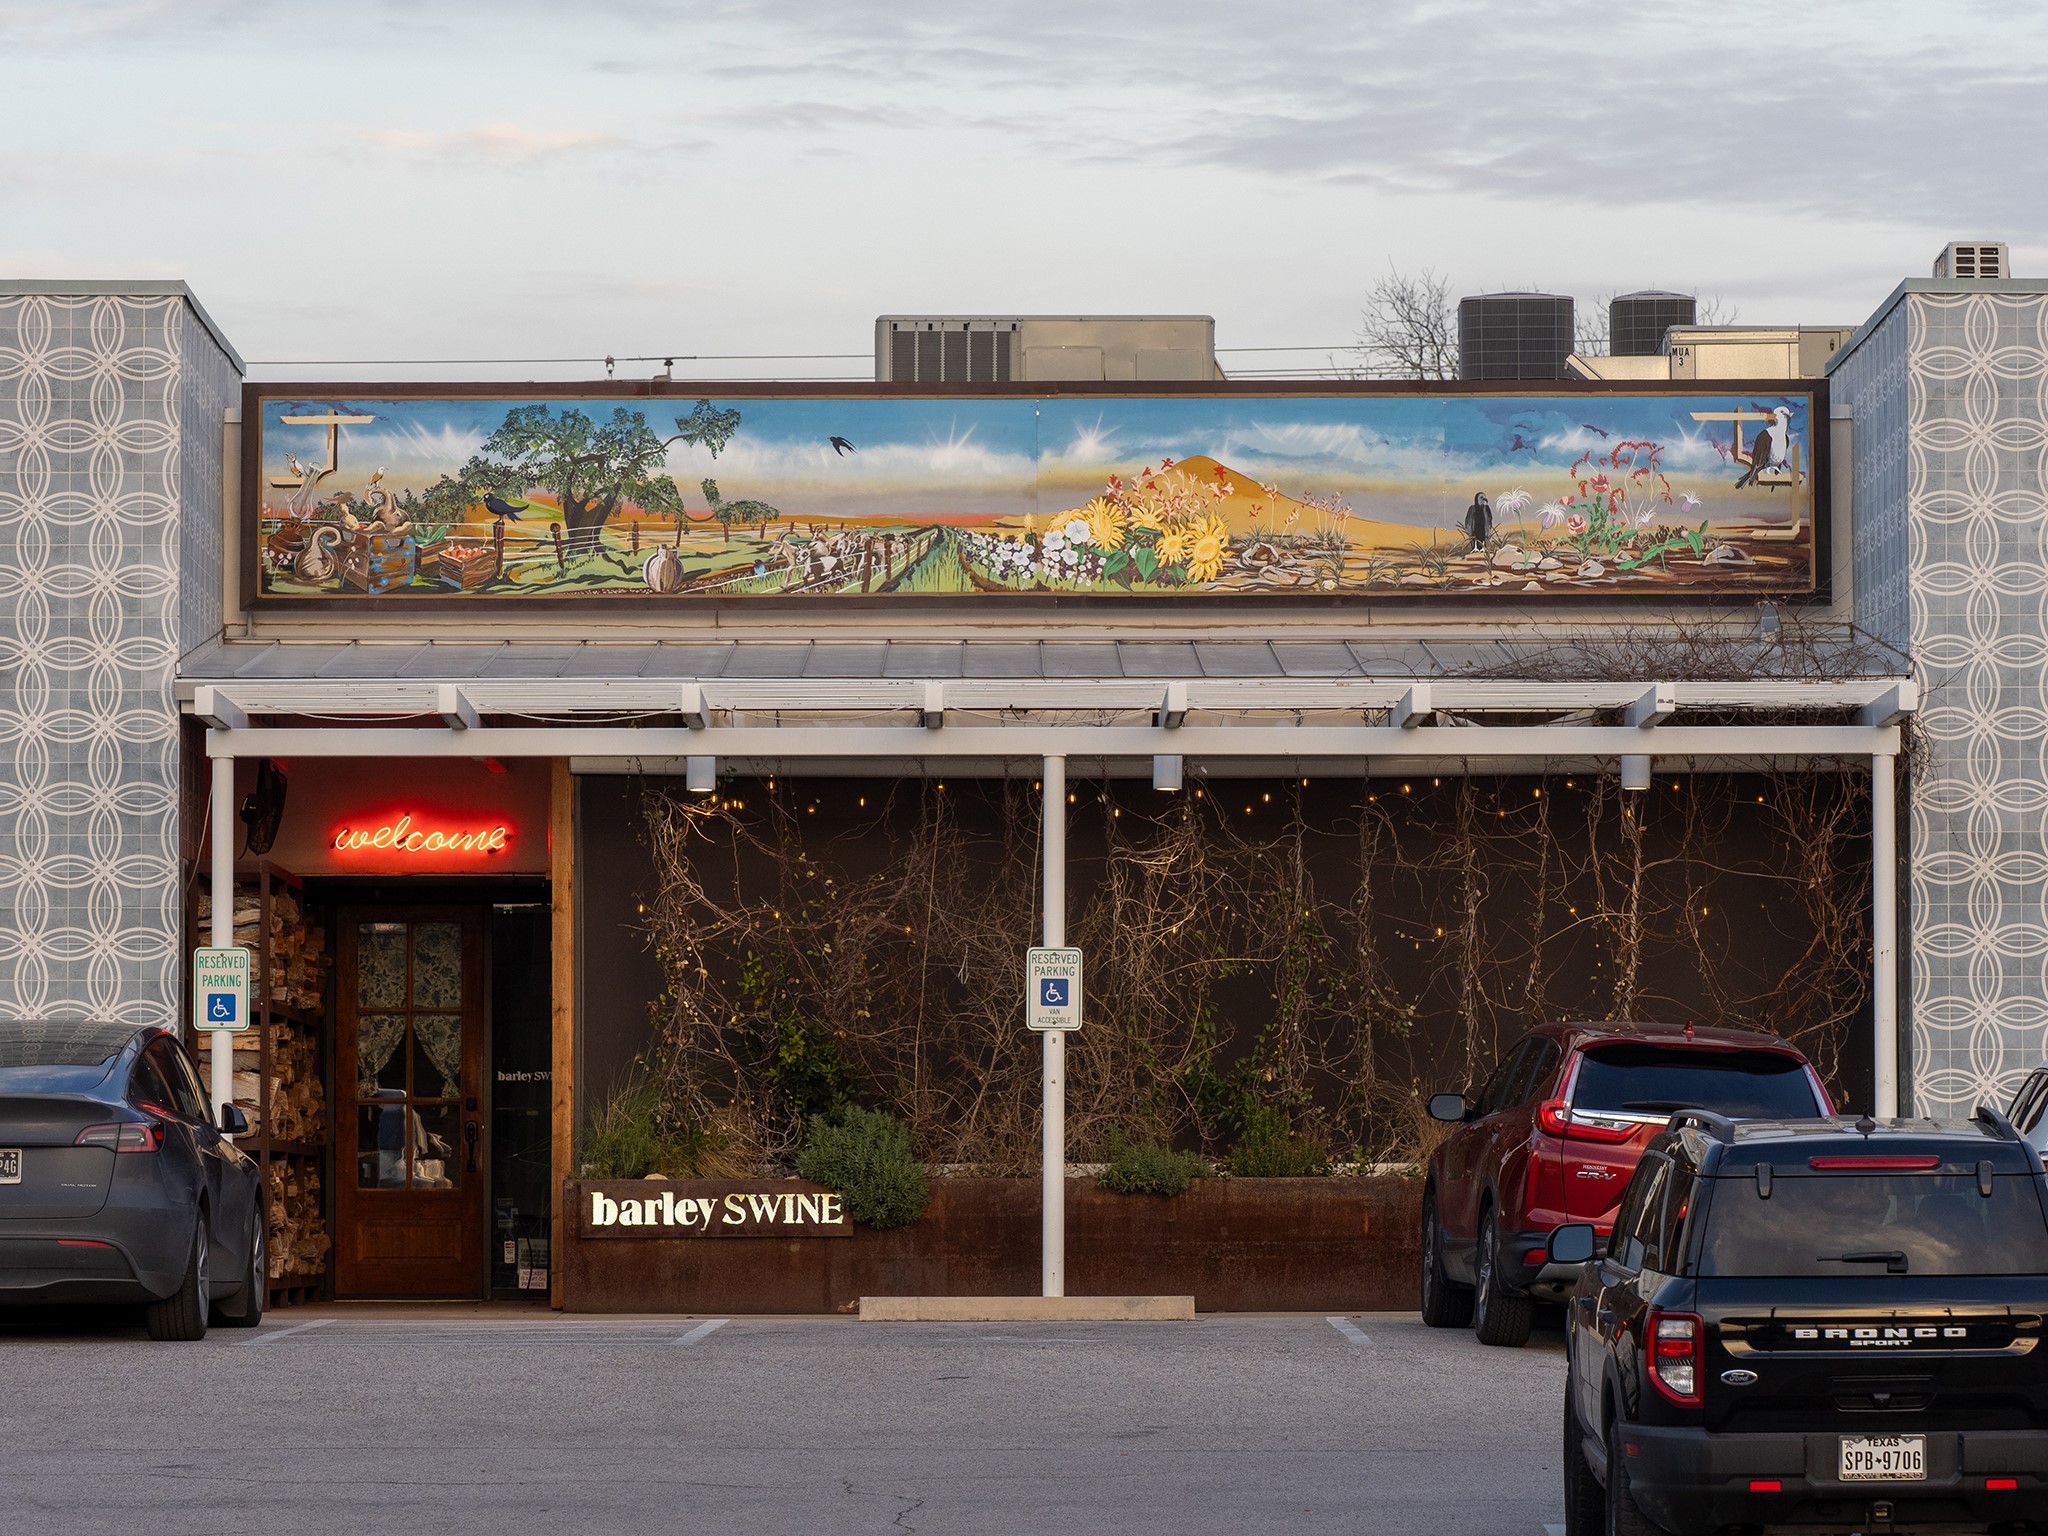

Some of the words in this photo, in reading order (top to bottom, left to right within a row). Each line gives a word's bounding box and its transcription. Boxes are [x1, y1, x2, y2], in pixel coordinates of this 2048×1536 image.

[1672, 347, 1690, 356] MUA
[1679, 357, 1684, 366] 3
[334, 815, 507, 853] welcome
[198, 955, 246, 969] RESERVED
[1032, 954, 1078, 964] RESERVED
[1034, 966, 1076, 977] PARKING
[202, 974, 242, 988] PARKING
[1037, 1016, 1072, 1024] ACCESSIBLE
[497, 1071, 533, 1083] barley
[533, 1071, 552, 1080] SW
[1576, 1171, 1617, 1181] CR-V
[590, 1191, 718, 1232] barley
[722, 1193, 844, 1225] SWINE
[1794, 1327, 1967, 1339] BRONCO
[1728, 1373, 1749, 1382] Ford
[1867, 1438, 1900, 1447] TEXAS
[1845, 1451, 1873, 1470] SPB
[1882, 1451, 1921, 1470] 9706
